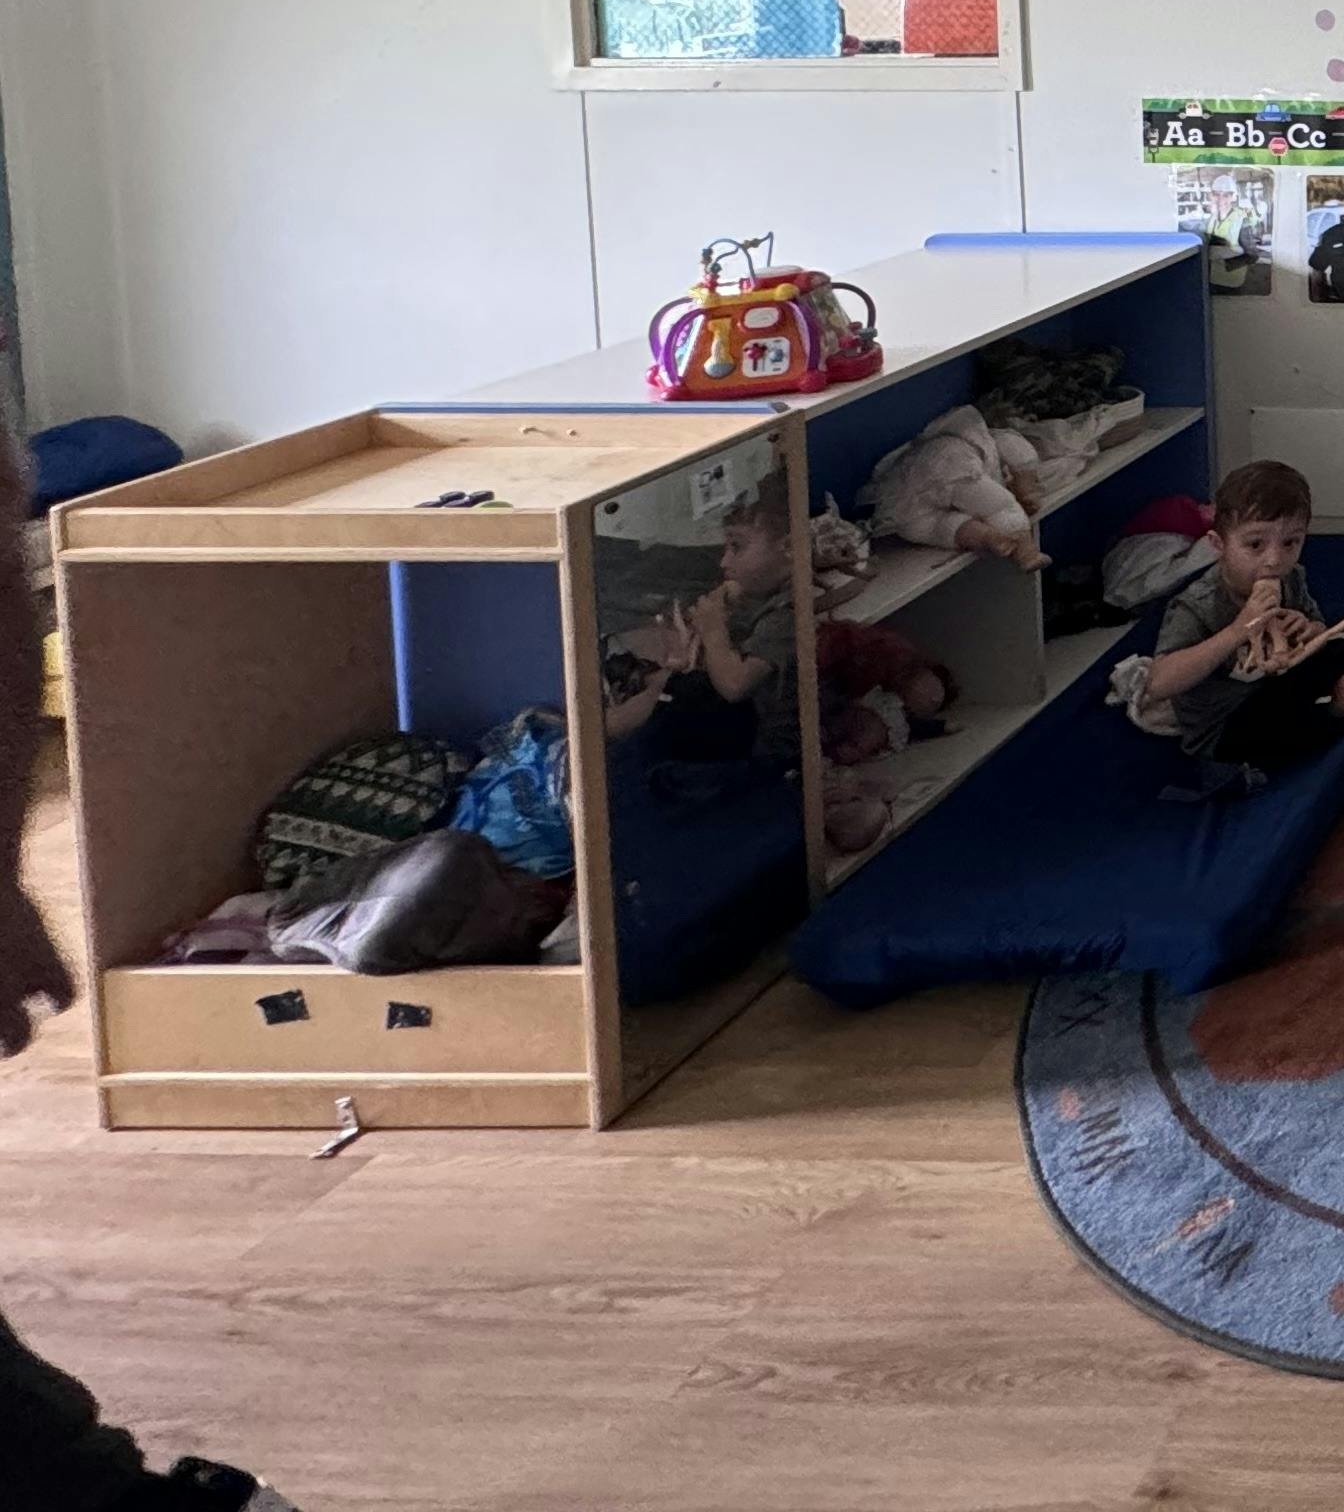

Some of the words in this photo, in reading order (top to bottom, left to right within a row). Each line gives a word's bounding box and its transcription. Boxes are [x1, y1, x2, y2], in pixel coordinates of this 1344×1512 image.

[1162, 121, 1205, 146] Aa
[1226, 120, 1265, 148] Bb
[1287, 123, 1326, 148] Cc
[1072, 1105, 1136, 1185] Ww
[1187, 1226, 1256, 1289] Vv
